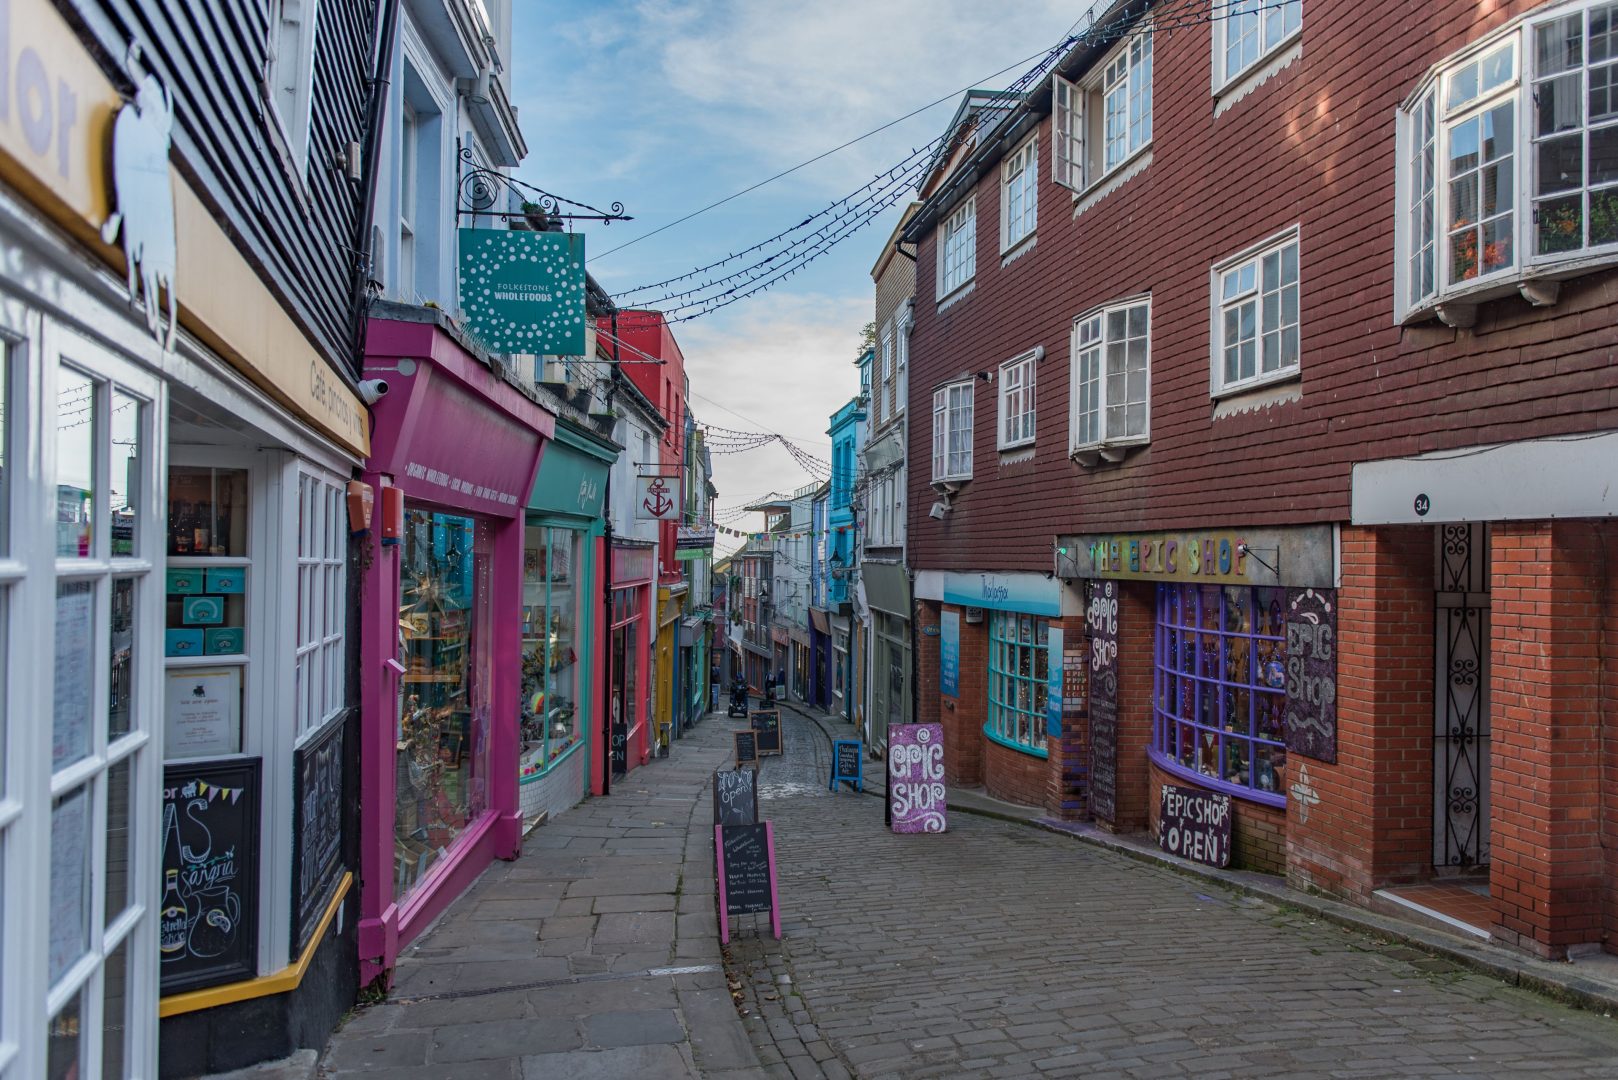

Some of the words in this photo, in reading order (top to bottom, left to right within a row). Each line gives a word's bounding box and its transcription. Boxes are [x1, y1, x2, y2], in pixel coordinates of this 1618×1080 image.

[494, 291, 553, 302] WHOLEFOODS
[497, 283, 549, 292] FOLKESTONE
[1416, 499, 1428, 511] 34
[1089, 540, 1121, 573] THE
[1129, 539, 1178, 574] EPIC
[1188, 537, 1246, 576] SHOP
[1287, 622, 1332, 660] EPIC
[612, 734, 626, 747] OP
[892, 782, 946, 817] SHOP
[1168, 827, 1218, 863] OPEN
